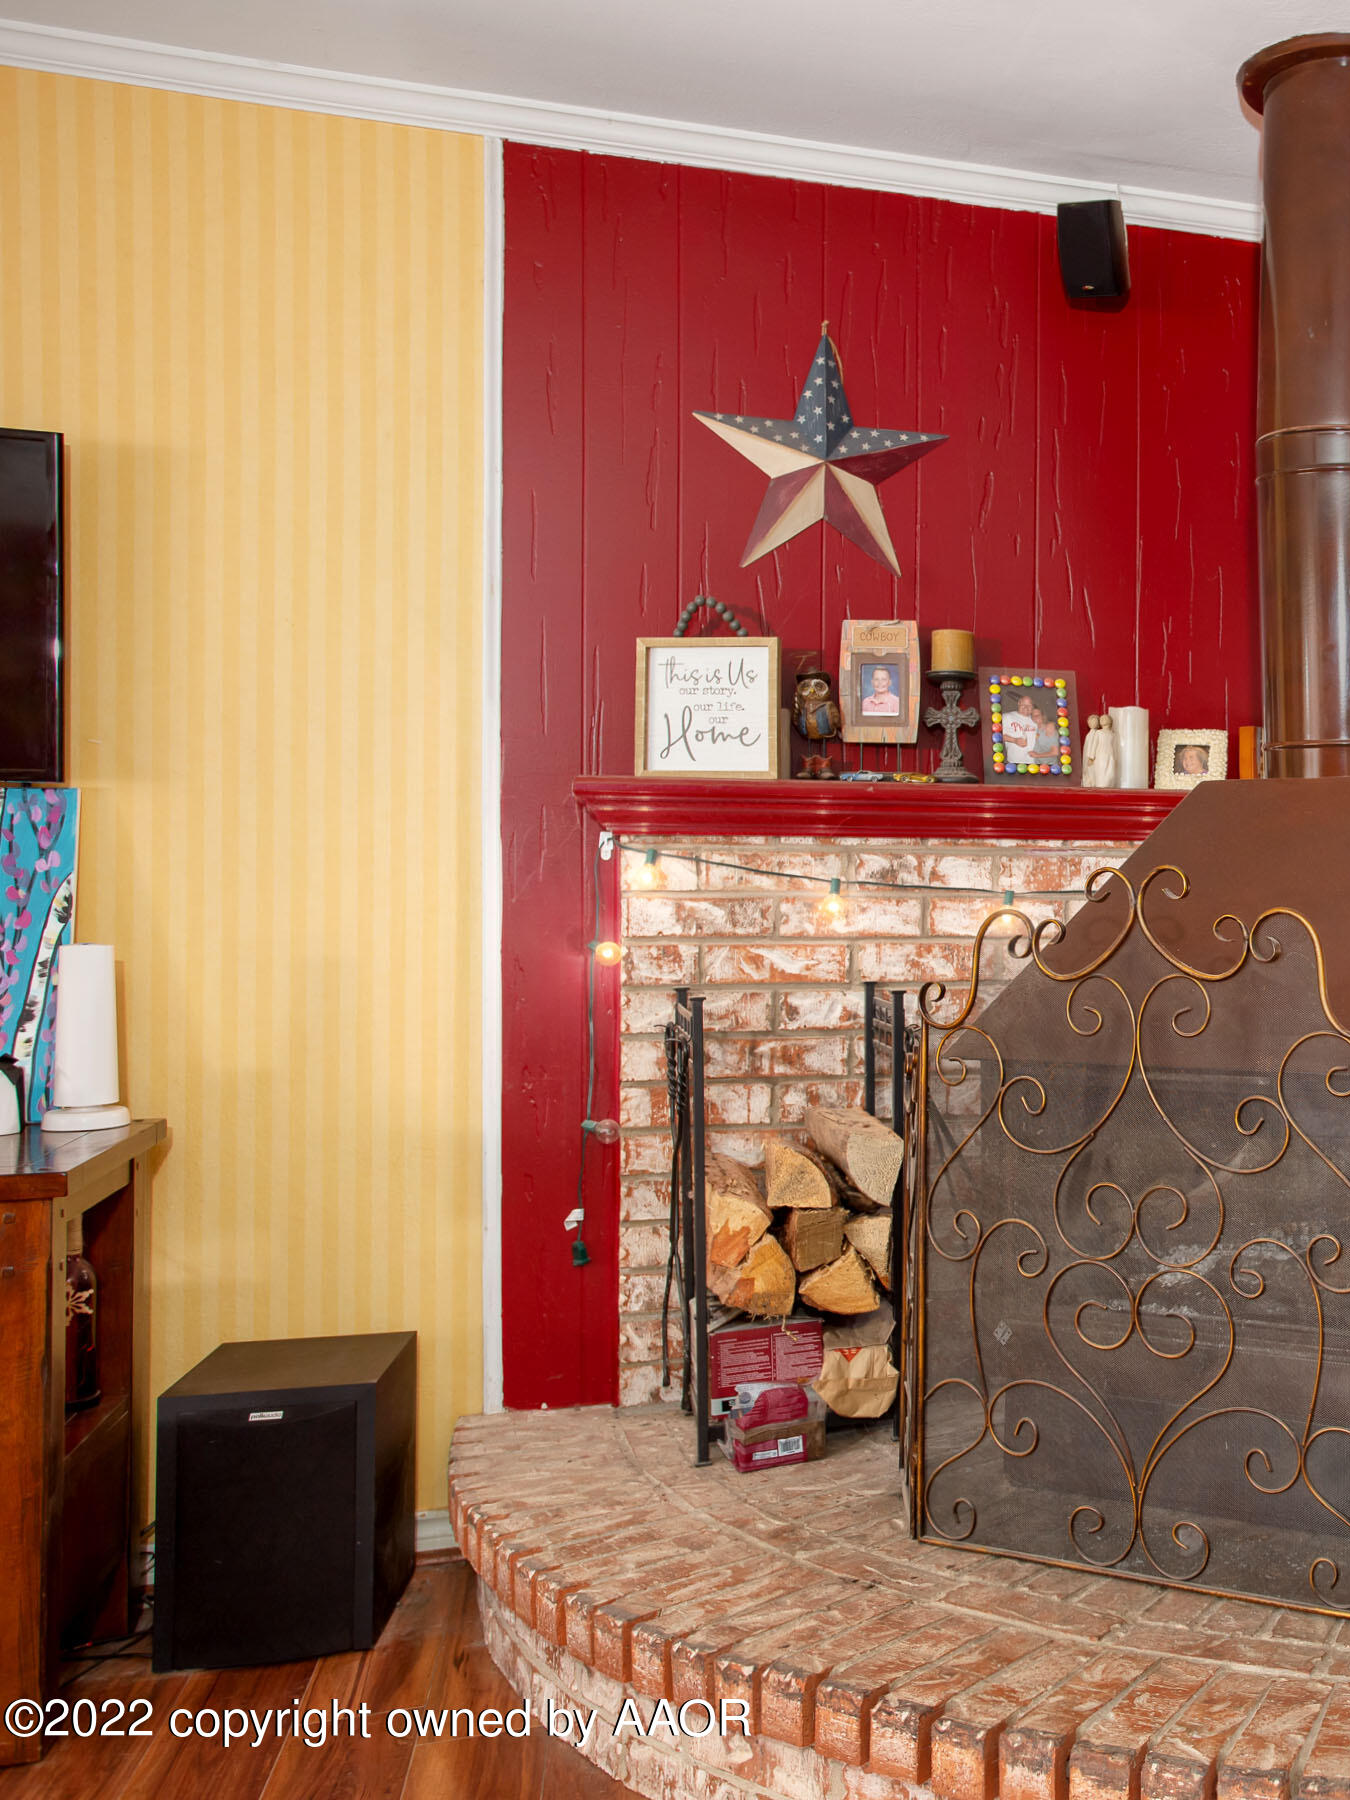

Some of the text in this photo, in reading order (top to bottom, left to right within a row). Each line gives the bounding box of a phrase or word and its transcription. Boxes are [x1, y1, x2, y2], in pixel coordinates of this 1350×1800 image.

[860, 631, 898, 641] COWBOY
[706, 667, 723, 684] is
[728, 657, 758, 689] Us
[679, 685, 737, 697] our story.
[693, 701, 745, 711] our life.
[708, 716, 728, 724] our
[659, 705, 762, 762] Home
